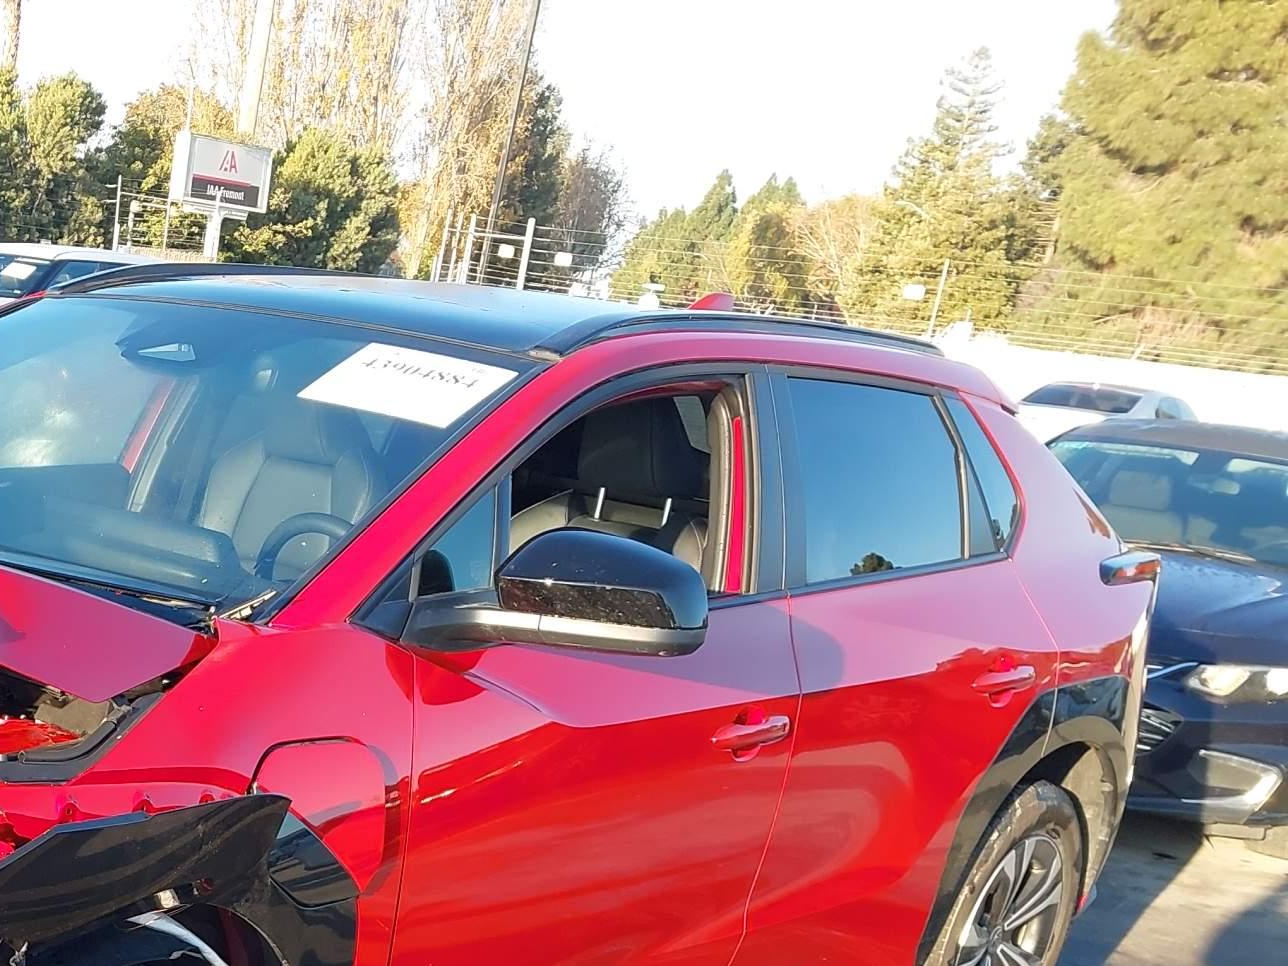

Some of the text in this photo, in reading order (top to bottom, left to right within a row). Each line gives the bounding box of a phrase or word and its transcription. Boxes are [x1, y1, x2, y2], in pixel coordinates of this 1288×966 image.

[206, 184, 245, 201] IAA Fremont
[361, 358, 479, 389] 43904884
